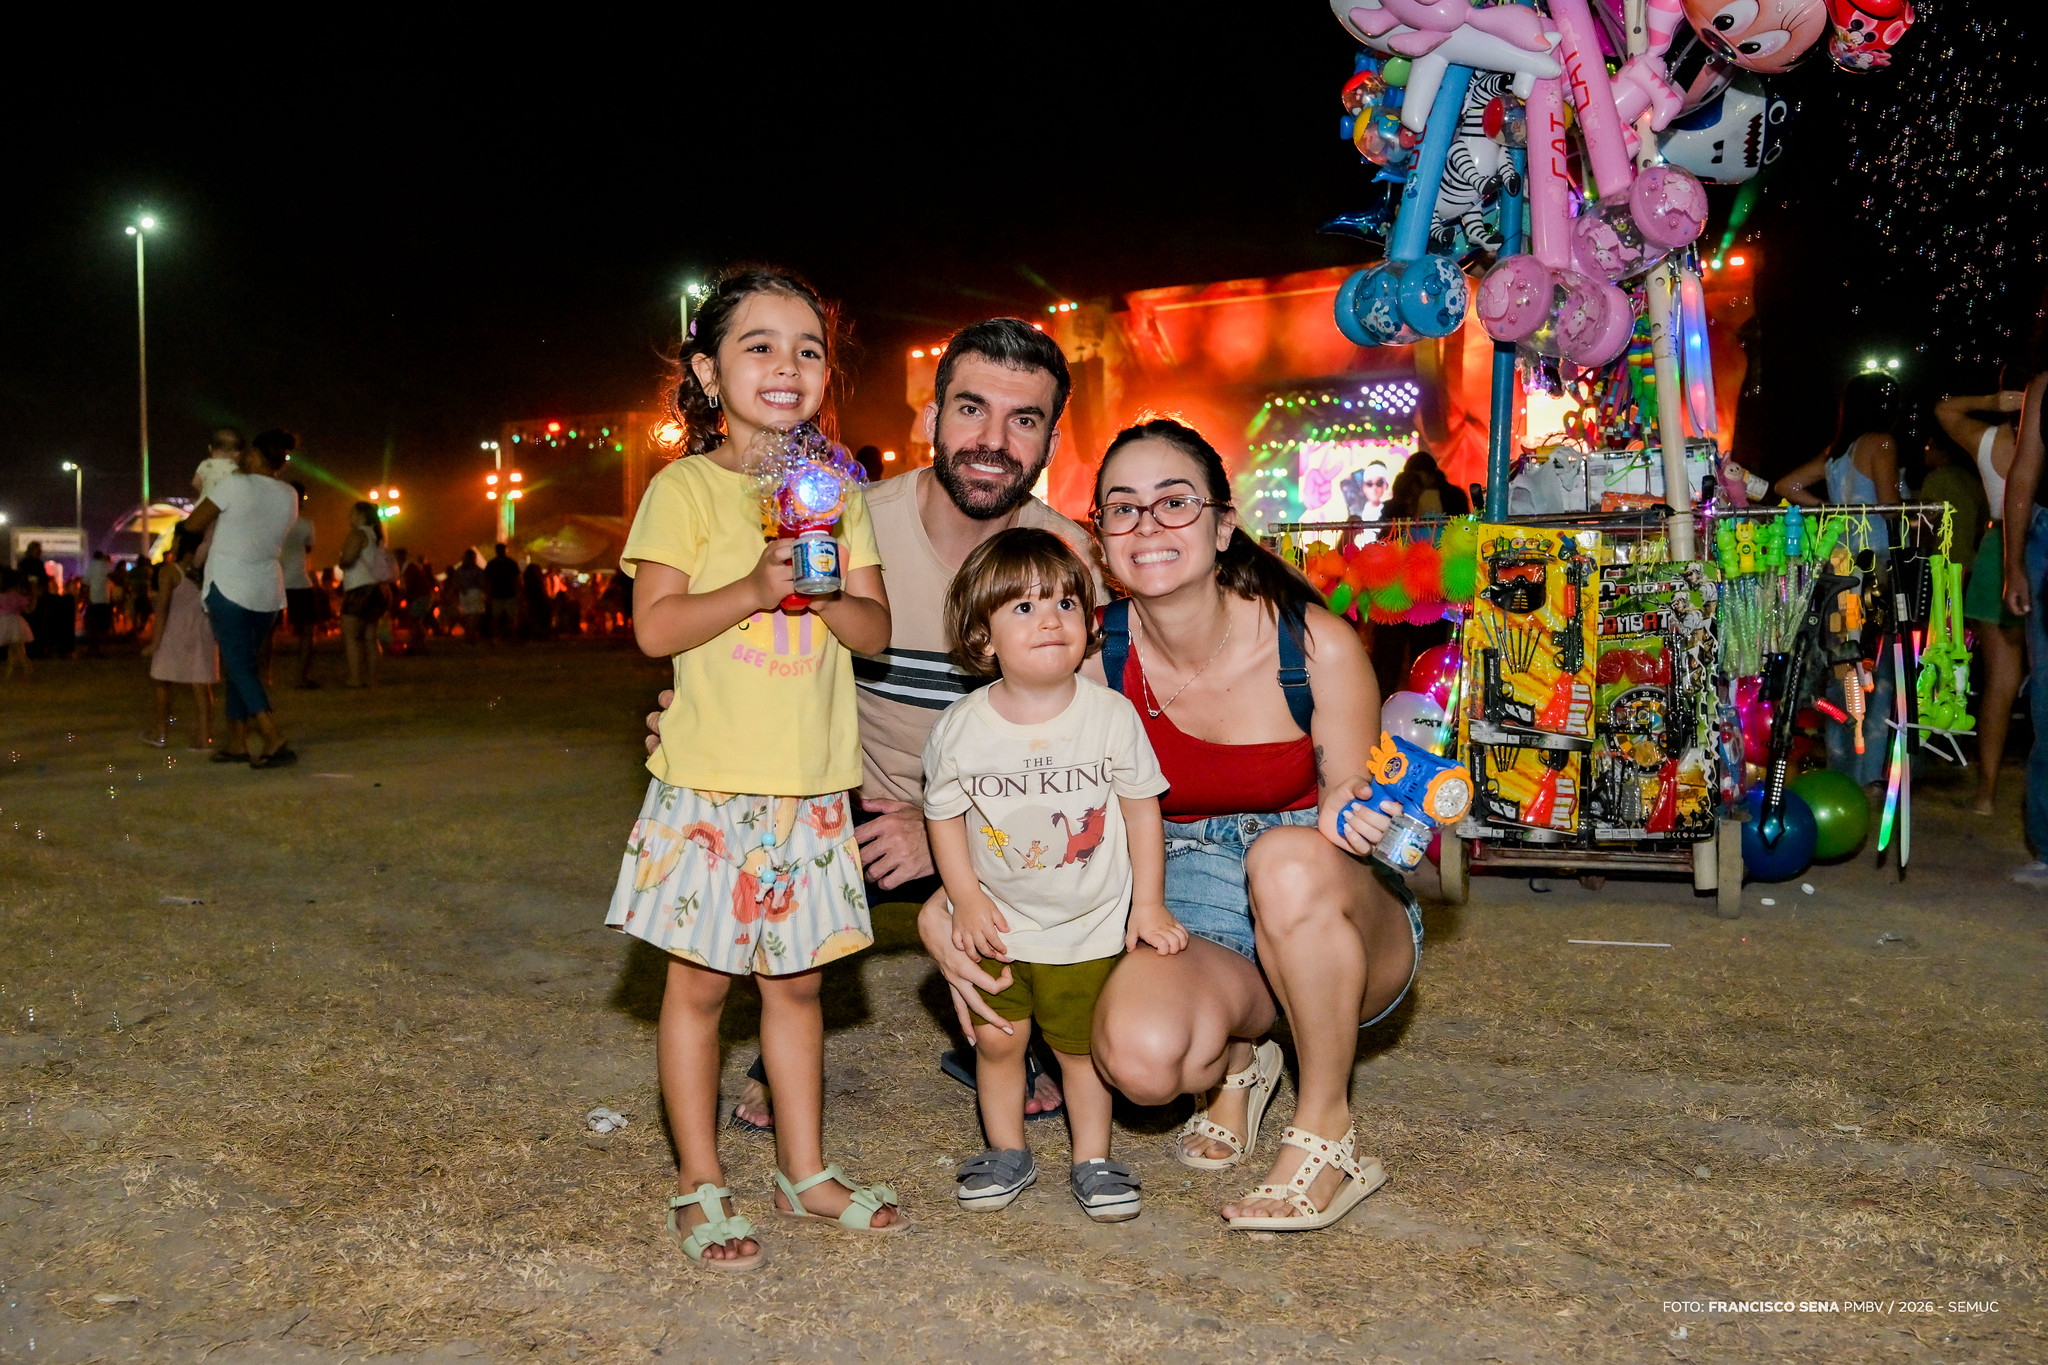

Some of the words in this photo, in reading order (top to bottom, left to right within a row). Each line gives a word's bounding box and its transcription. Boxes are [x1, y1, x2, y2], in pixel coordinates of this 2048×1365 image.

[731, 643, 767, 669] BEE
[768, 655, 824, 677] POSITI
[1023, 756, 1053, 769] THE
[970, 774, 1028, 798] ION
